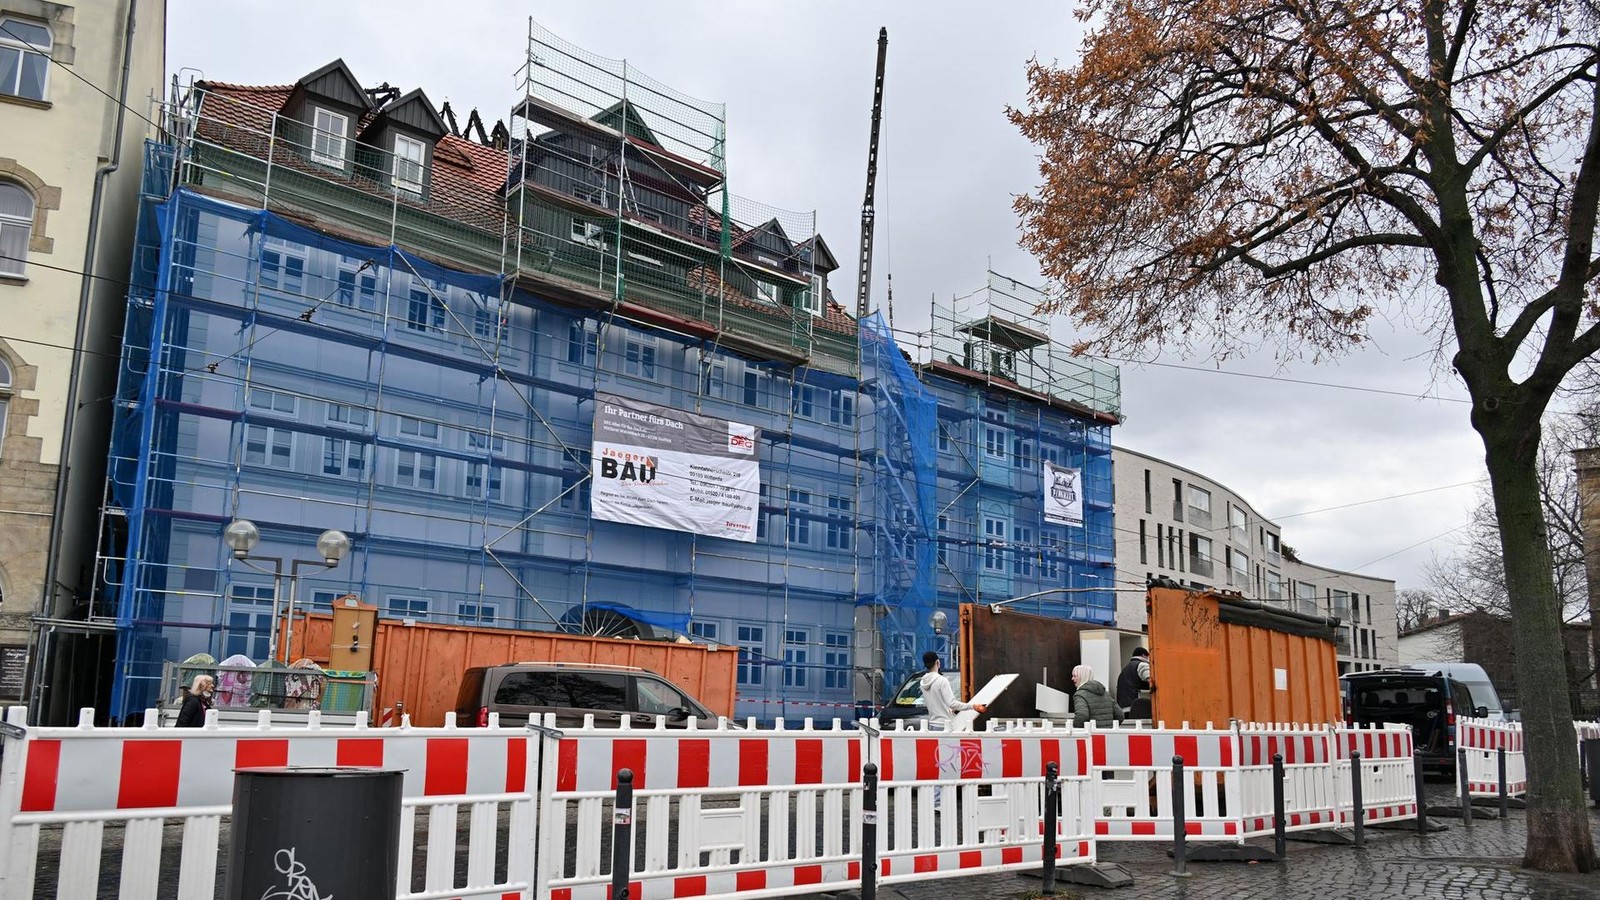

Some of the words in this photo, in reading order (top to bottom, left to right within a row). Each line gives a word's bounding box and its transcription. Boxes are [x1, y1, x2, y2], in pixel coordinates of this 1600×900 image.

[605, 406, 618, 415] Ihr
[619, 408, 647, 422] Partner
[649, 415, 664, 425] fürs
[665, 419, 683, 430] Dach
[731, 438, 752, 448] DEG
[602, 448, 644, 462] Jaeger
[601, 457, 656, 483] BAU
